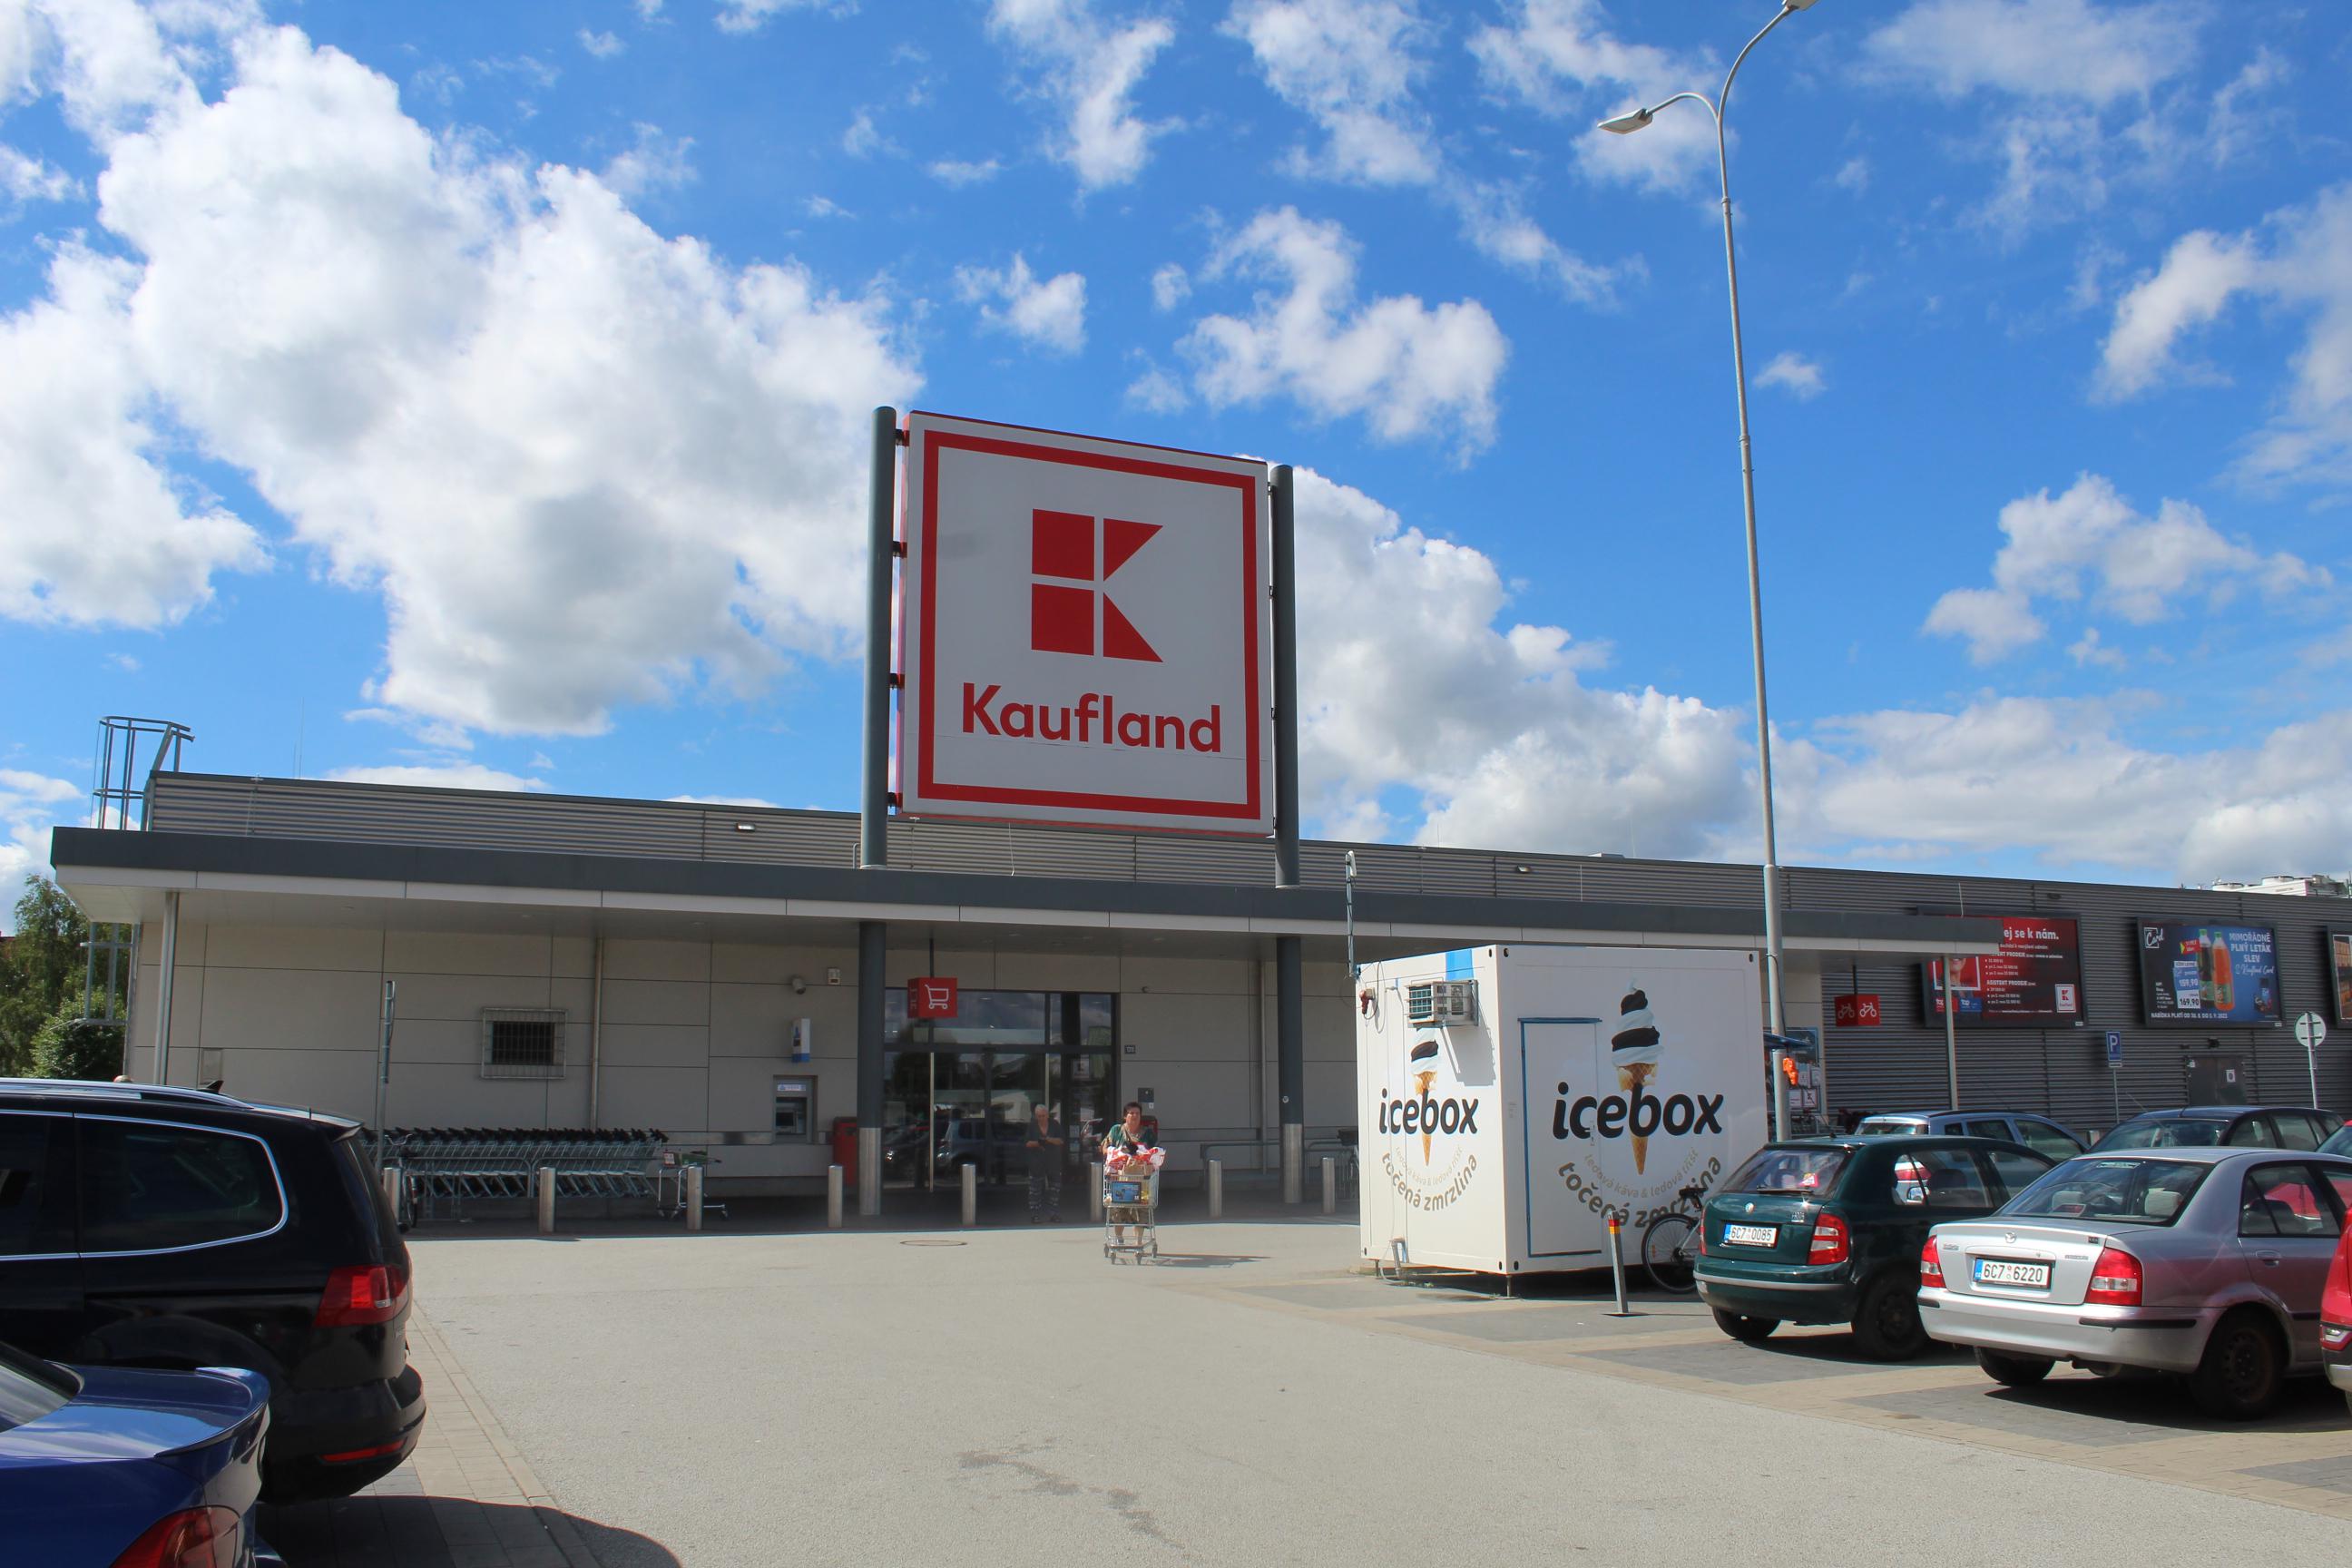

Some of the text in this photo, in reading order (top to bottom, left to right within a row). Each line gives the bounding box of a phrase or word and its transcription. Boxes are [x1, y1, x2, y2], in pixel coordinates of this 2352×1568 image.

[962, 681, 1222, 754] Kaufland
[2015, 929, 2025, 938] se
[2027, 926, 2034, 938] k
[2035, 928, 2059, 940] nám.
[2243, 955, 2260, 963] SLEV
[2109, 1034, 2119, 1052] P
[1378, 1087, 1479, 1135] icebox
[1553, 1081, 1724, 1140] icebox
[1382, 1152, 1478, 1211] točená zmrzlina
[1558, 1156, 1721, 1229] točená zmrzna
[1614, 1181, 1639, 1198] káva
[1641, 1188, 1649, 1198] &
[1651, 1170, 1683, 1198] ledová
[1730, 1227, 1772, 1241] 6C7 0085
[1984, 1263, 2043, 1282] 6C7 6220
